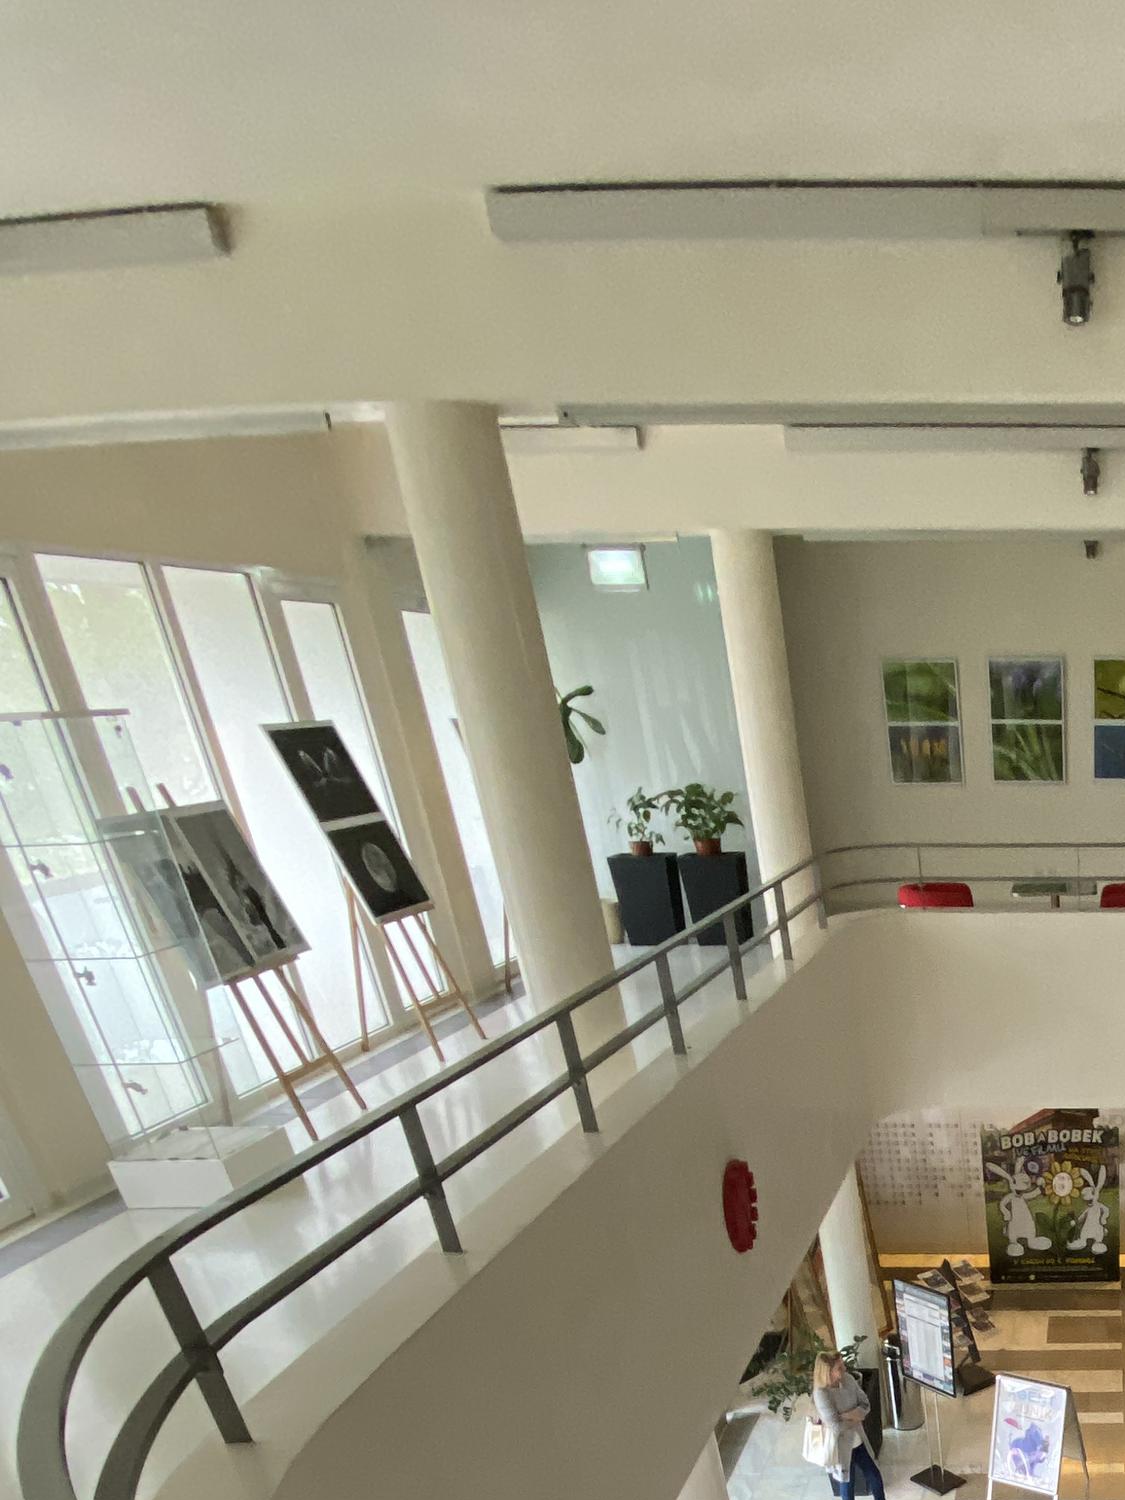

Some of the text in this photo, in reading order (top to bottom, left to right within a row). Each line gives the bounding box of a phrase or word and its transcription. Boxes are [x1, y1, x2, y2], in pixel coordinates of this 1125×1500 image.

[1001, 1129, 1104, 1150] BOB A BOBEK
